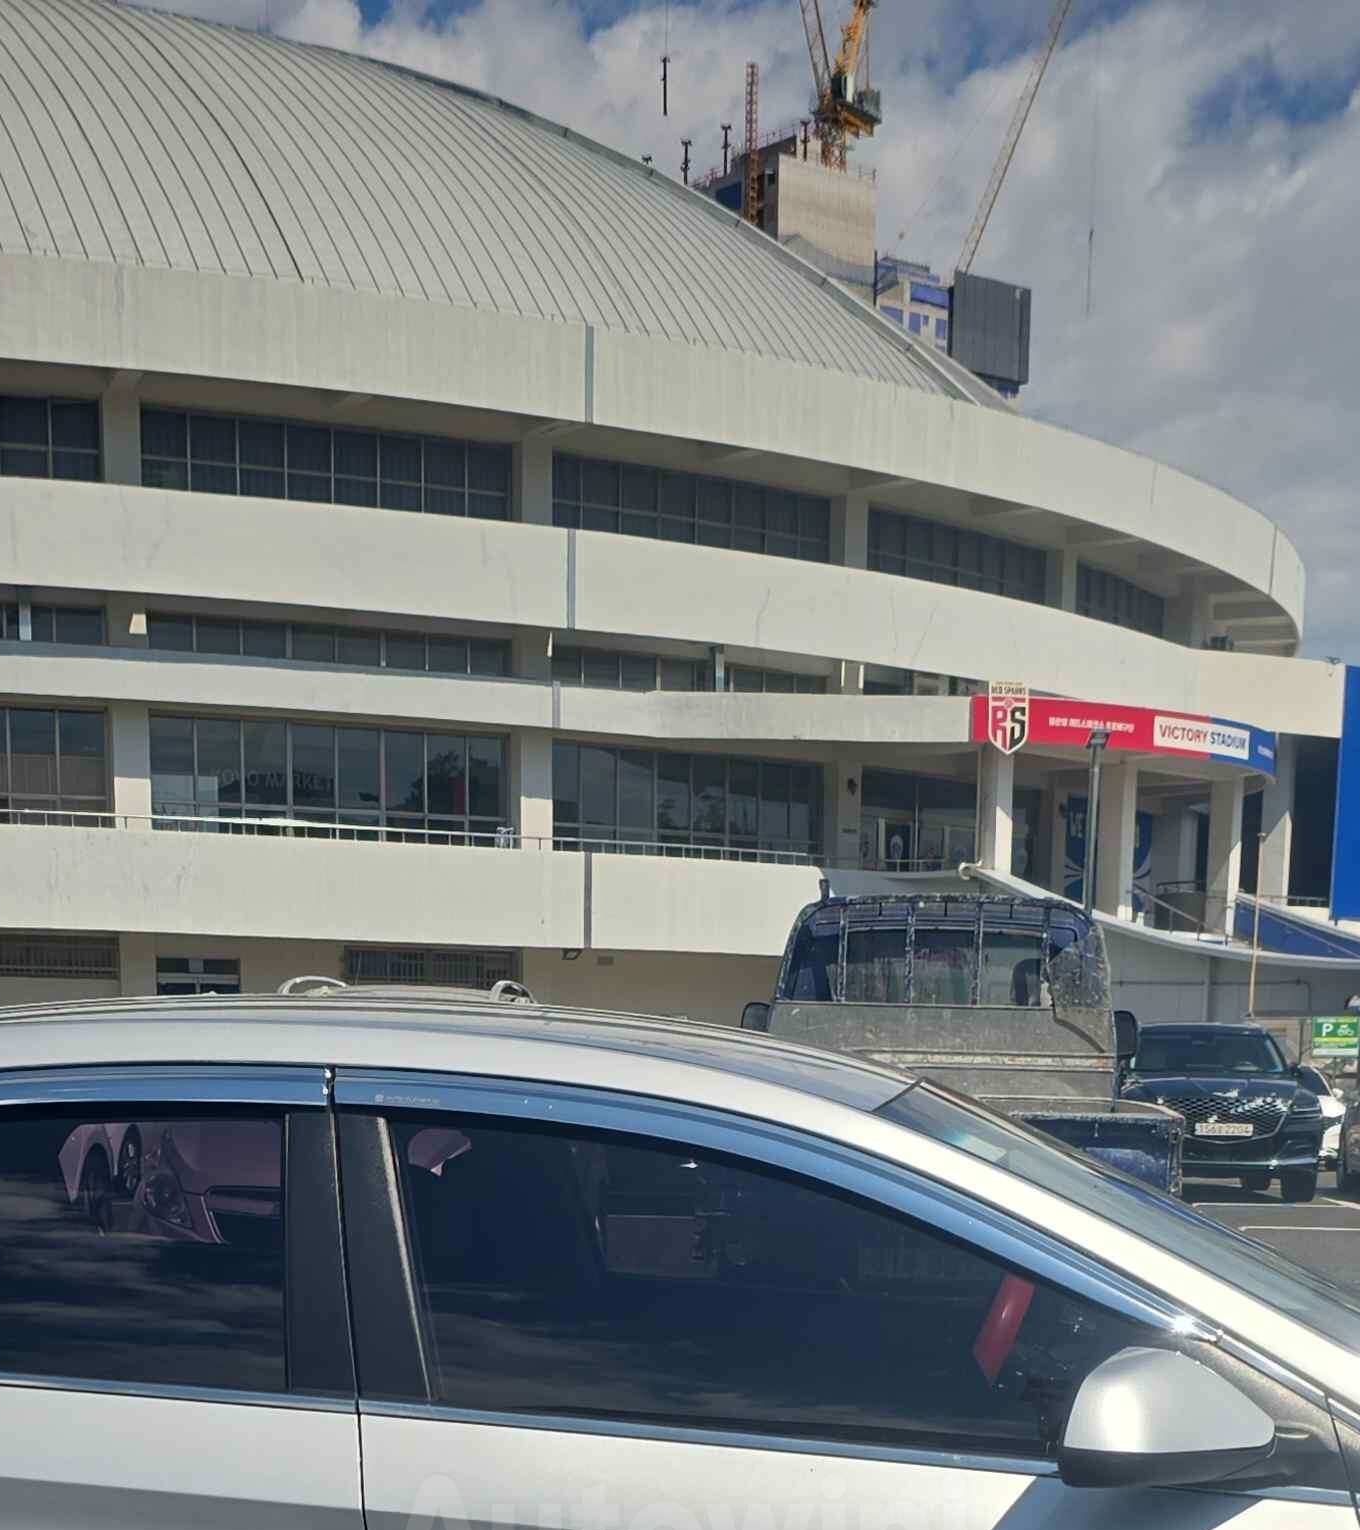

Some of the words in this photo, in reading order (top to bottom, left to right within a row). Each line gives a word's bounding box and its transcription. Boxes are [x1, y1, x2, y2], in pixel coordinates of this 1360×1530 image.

[1158, 723, 1208, 745] VICTORY
[1210, 727, 1248, 751] STADIUM
[1321, 1023, 1334, 1037] P
